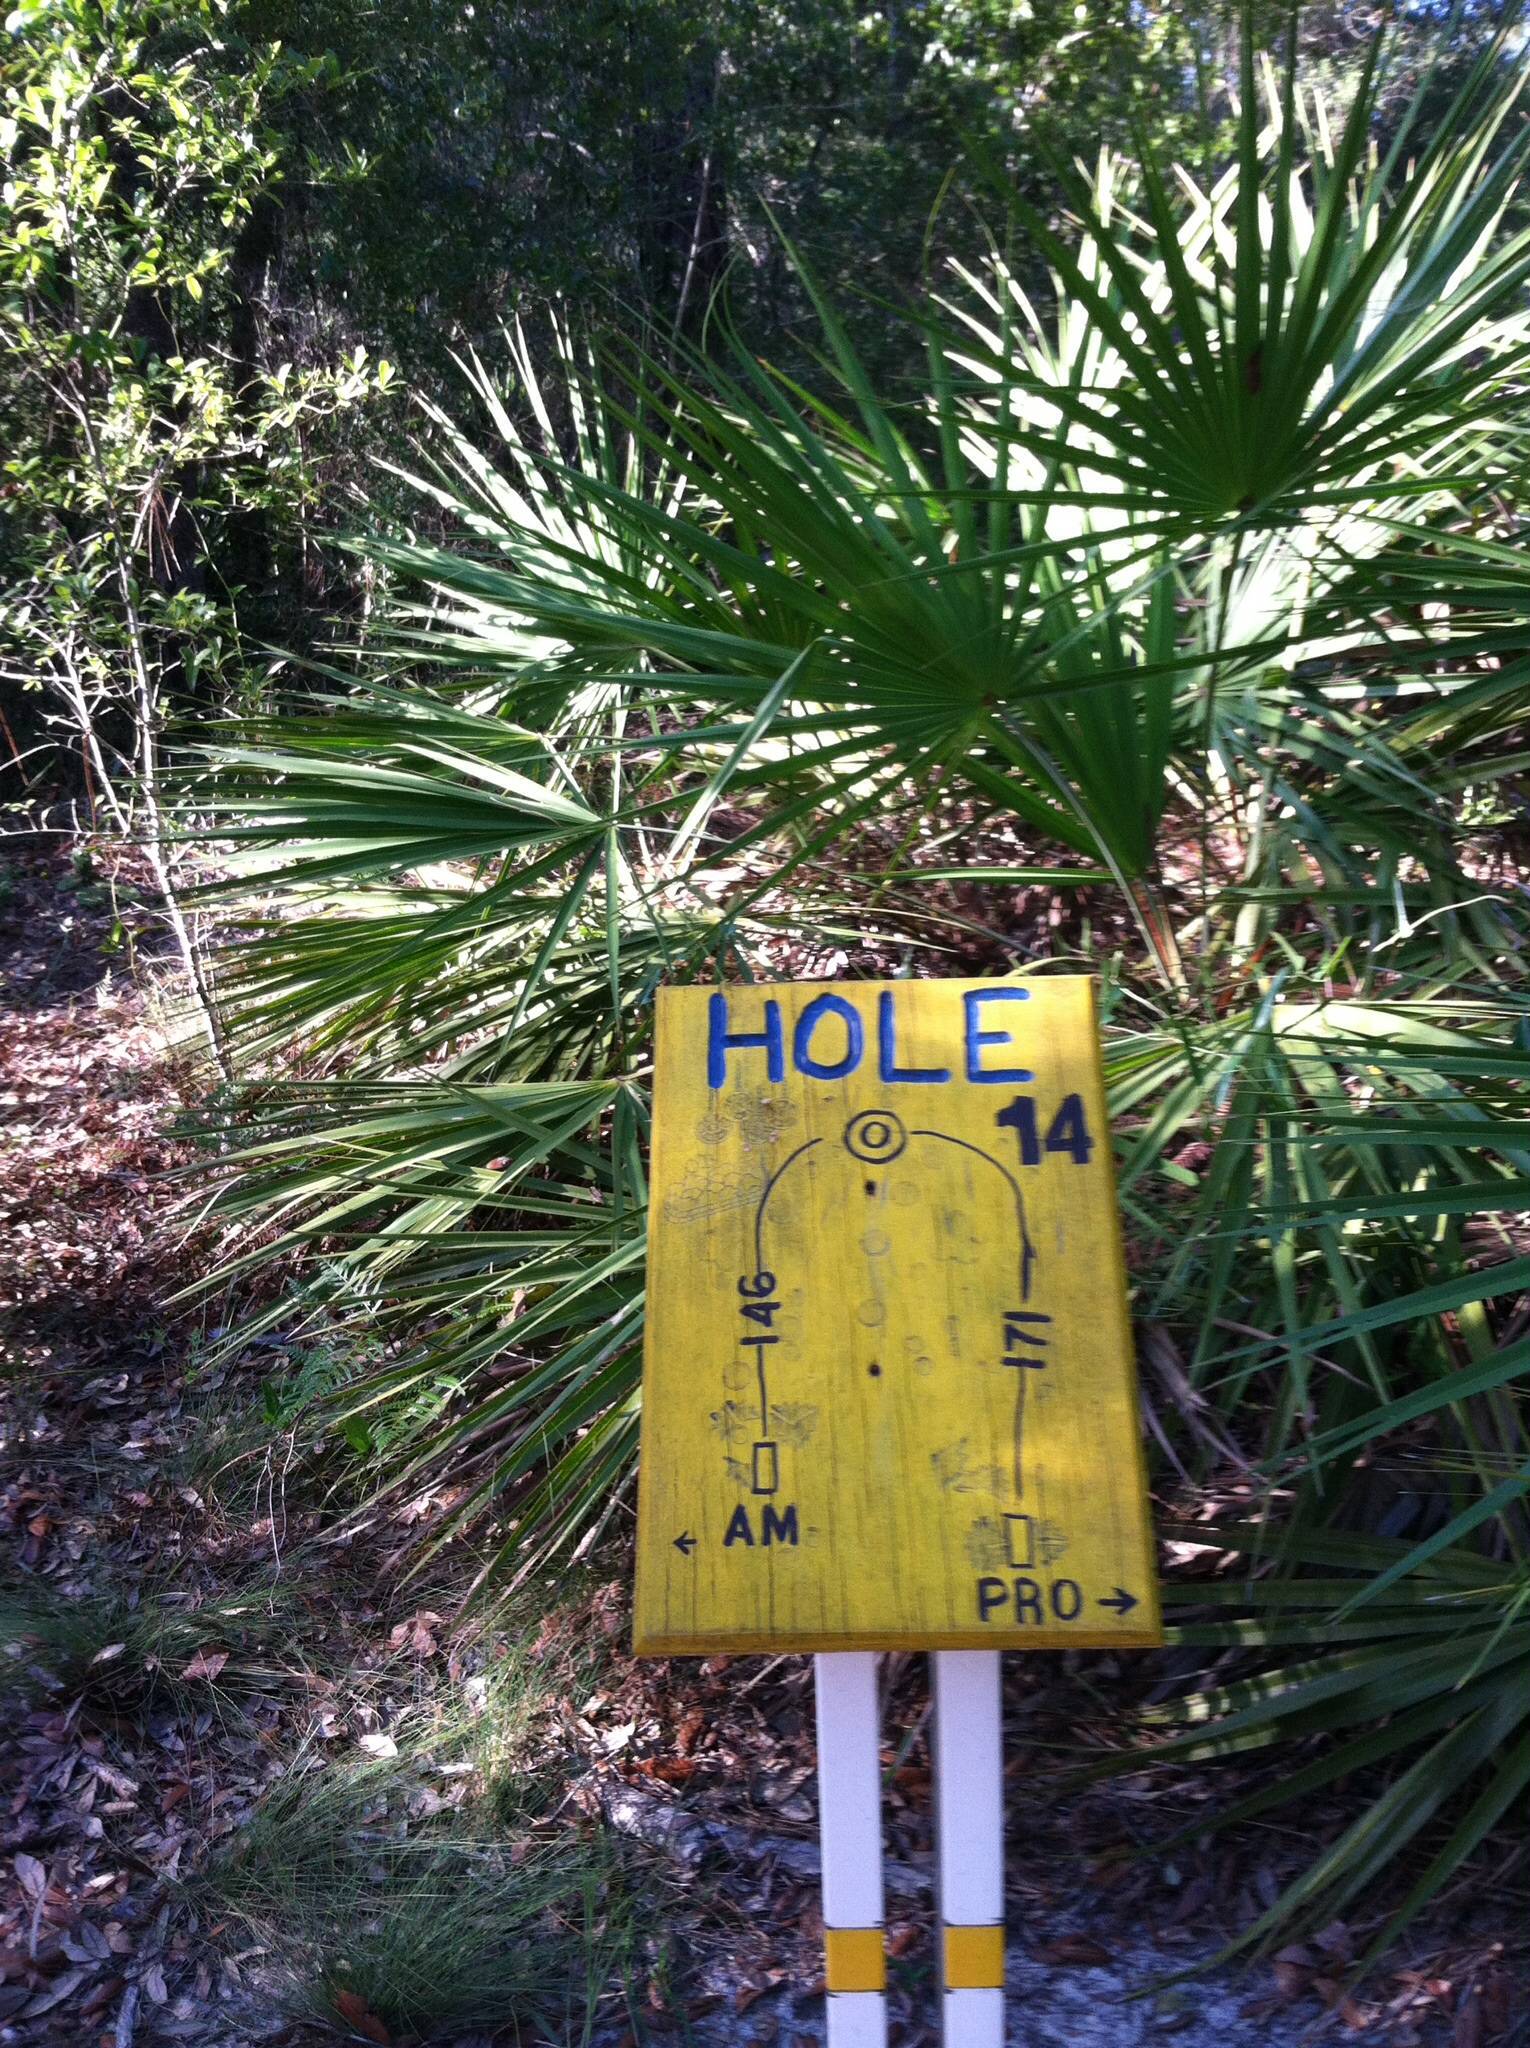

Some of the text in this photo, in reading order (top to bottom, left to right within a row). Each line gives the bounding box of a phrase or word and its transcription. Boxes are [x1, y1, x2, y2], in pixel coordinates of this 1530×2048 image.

[707, 985, 1036, 1089] HOLE
[996, 1093, 1094, 1165] 14
[738, 1270, 782, 1346] 146
[1002, 1310, 1053, 1369] 171
[722, 1503, 799, 1547] AM
[977, 1576, 1083, 1625] PRO
